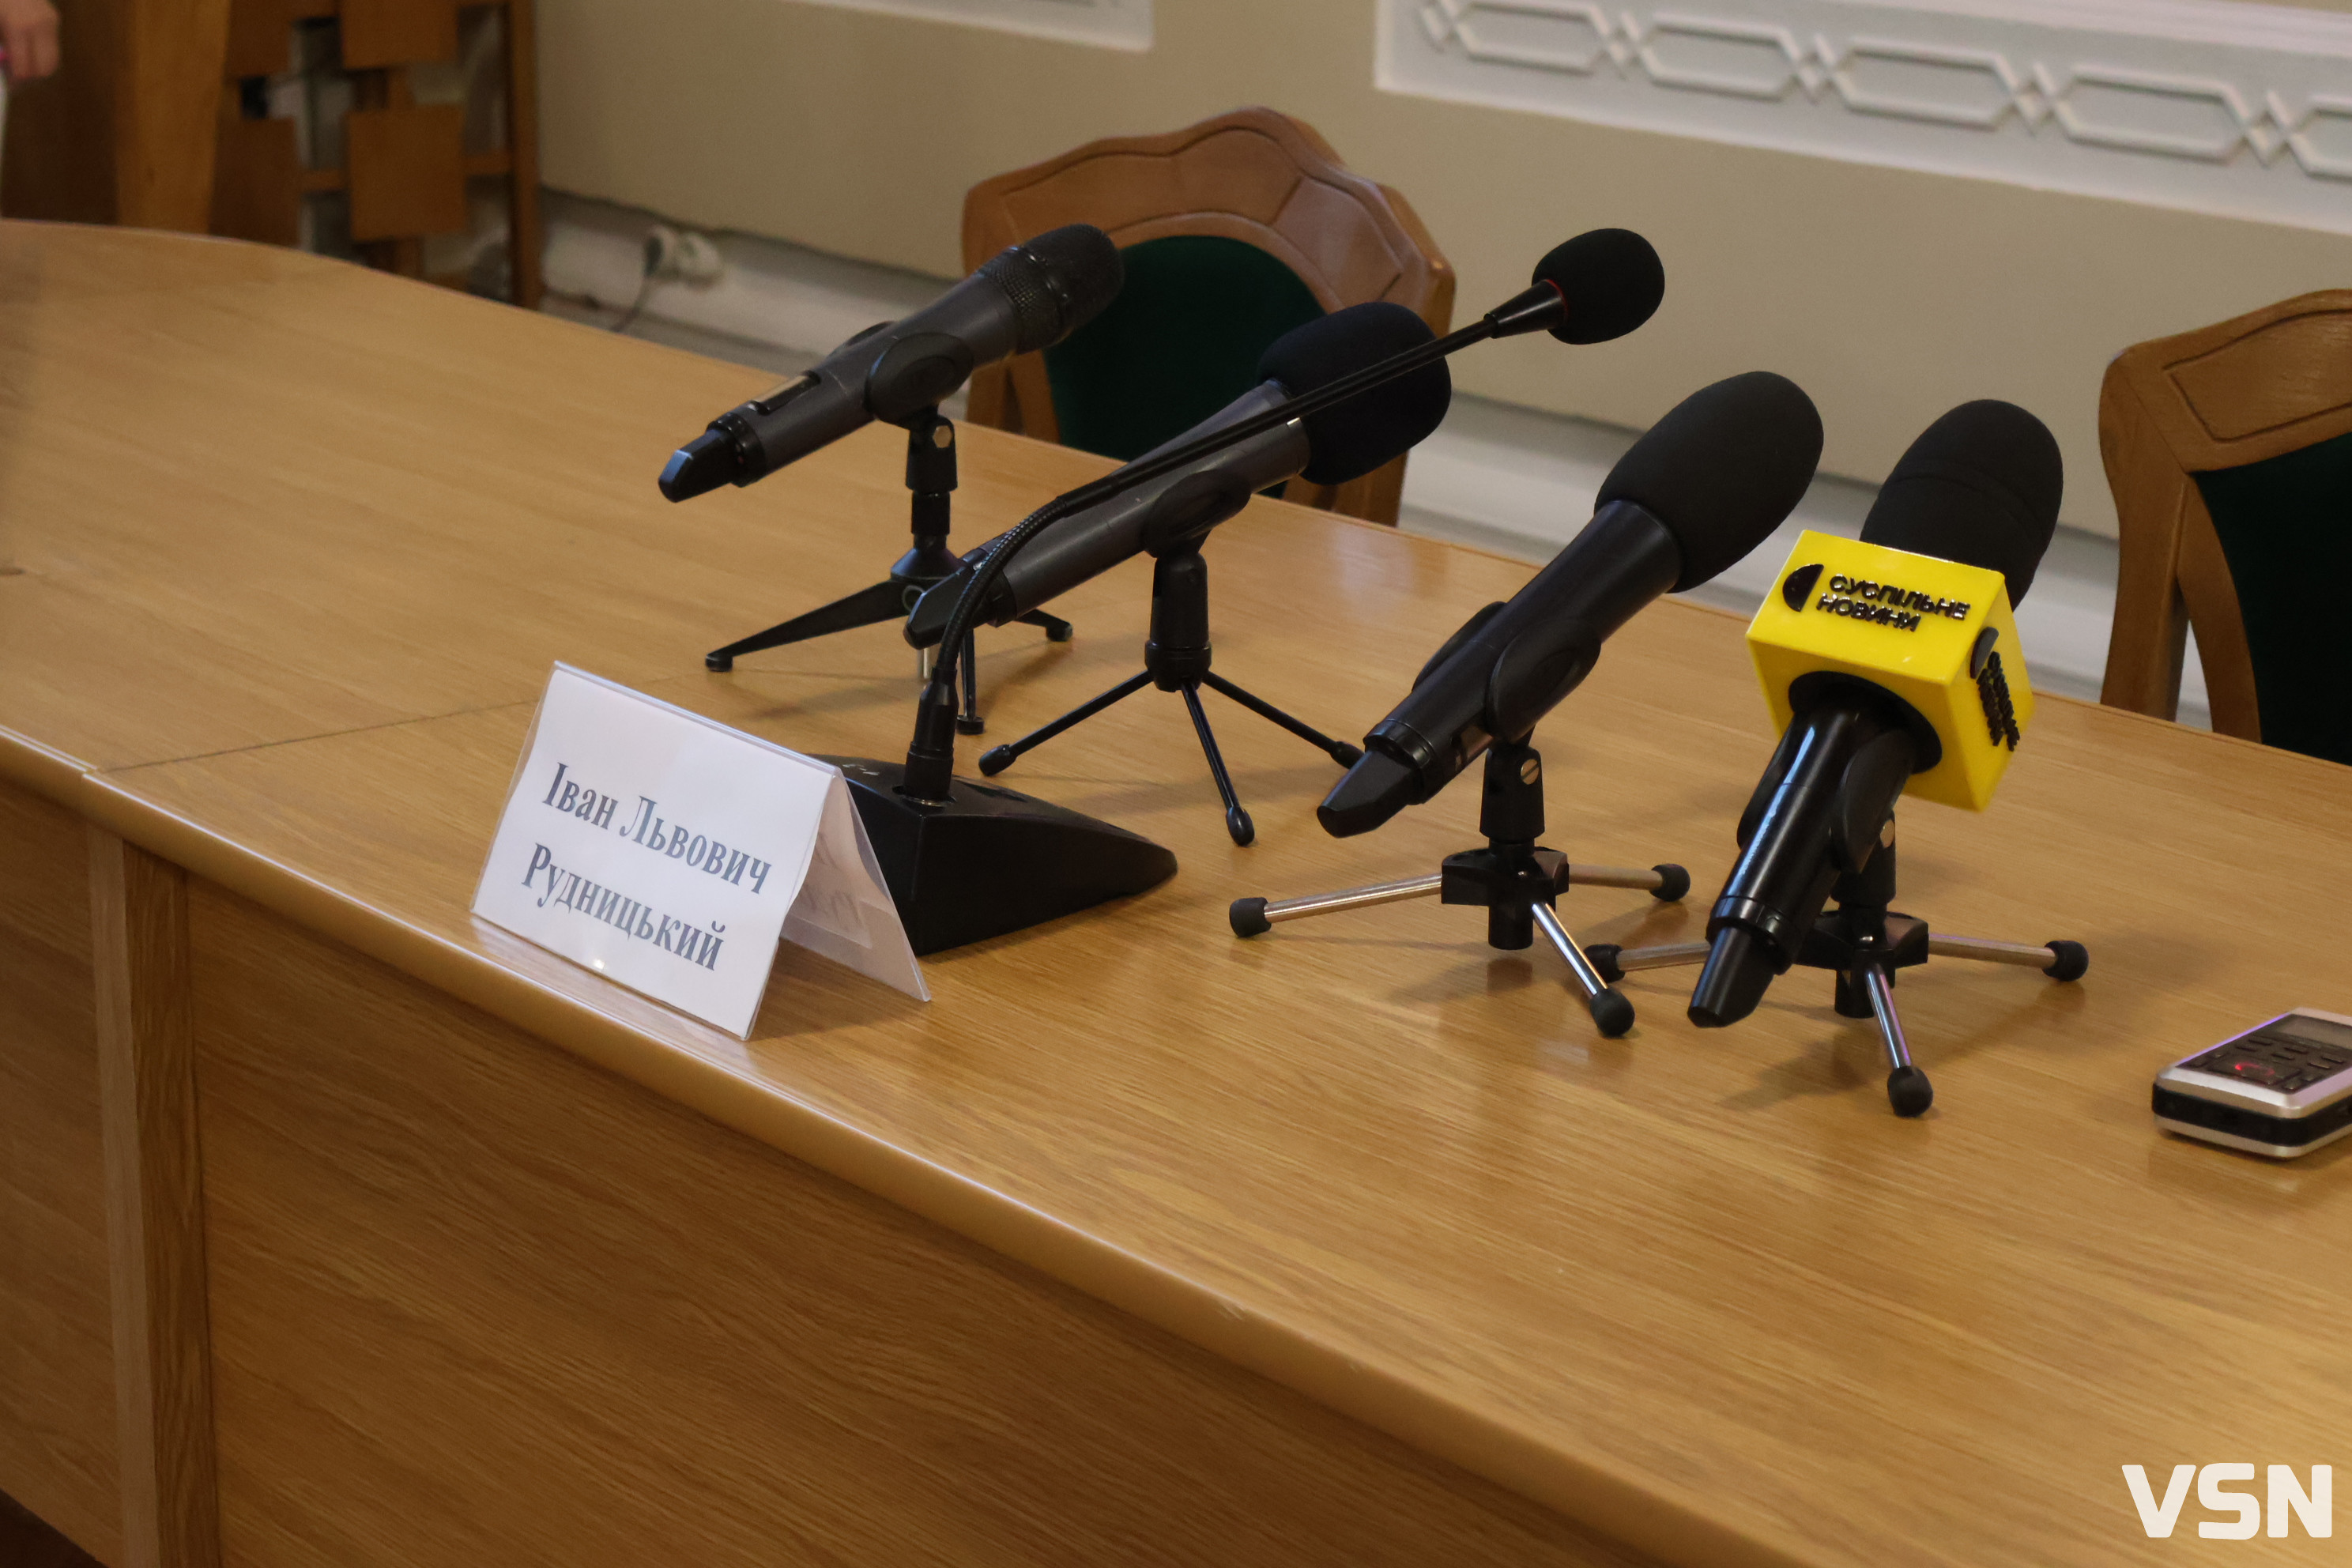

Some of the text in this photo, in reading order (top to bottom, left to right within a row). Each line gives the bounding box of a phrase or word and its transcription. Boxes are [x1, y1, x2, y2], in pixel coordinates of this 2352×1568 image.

[1816, 593, 1921, 632] НОВИНИ
[1830, 574, 1970, 620] СУСПІЛЬНЕ
[543, 763, 618, 829] Іван
[620, 796, 771, 894] Львович
[522, 843, 726, 971] Рудницький
